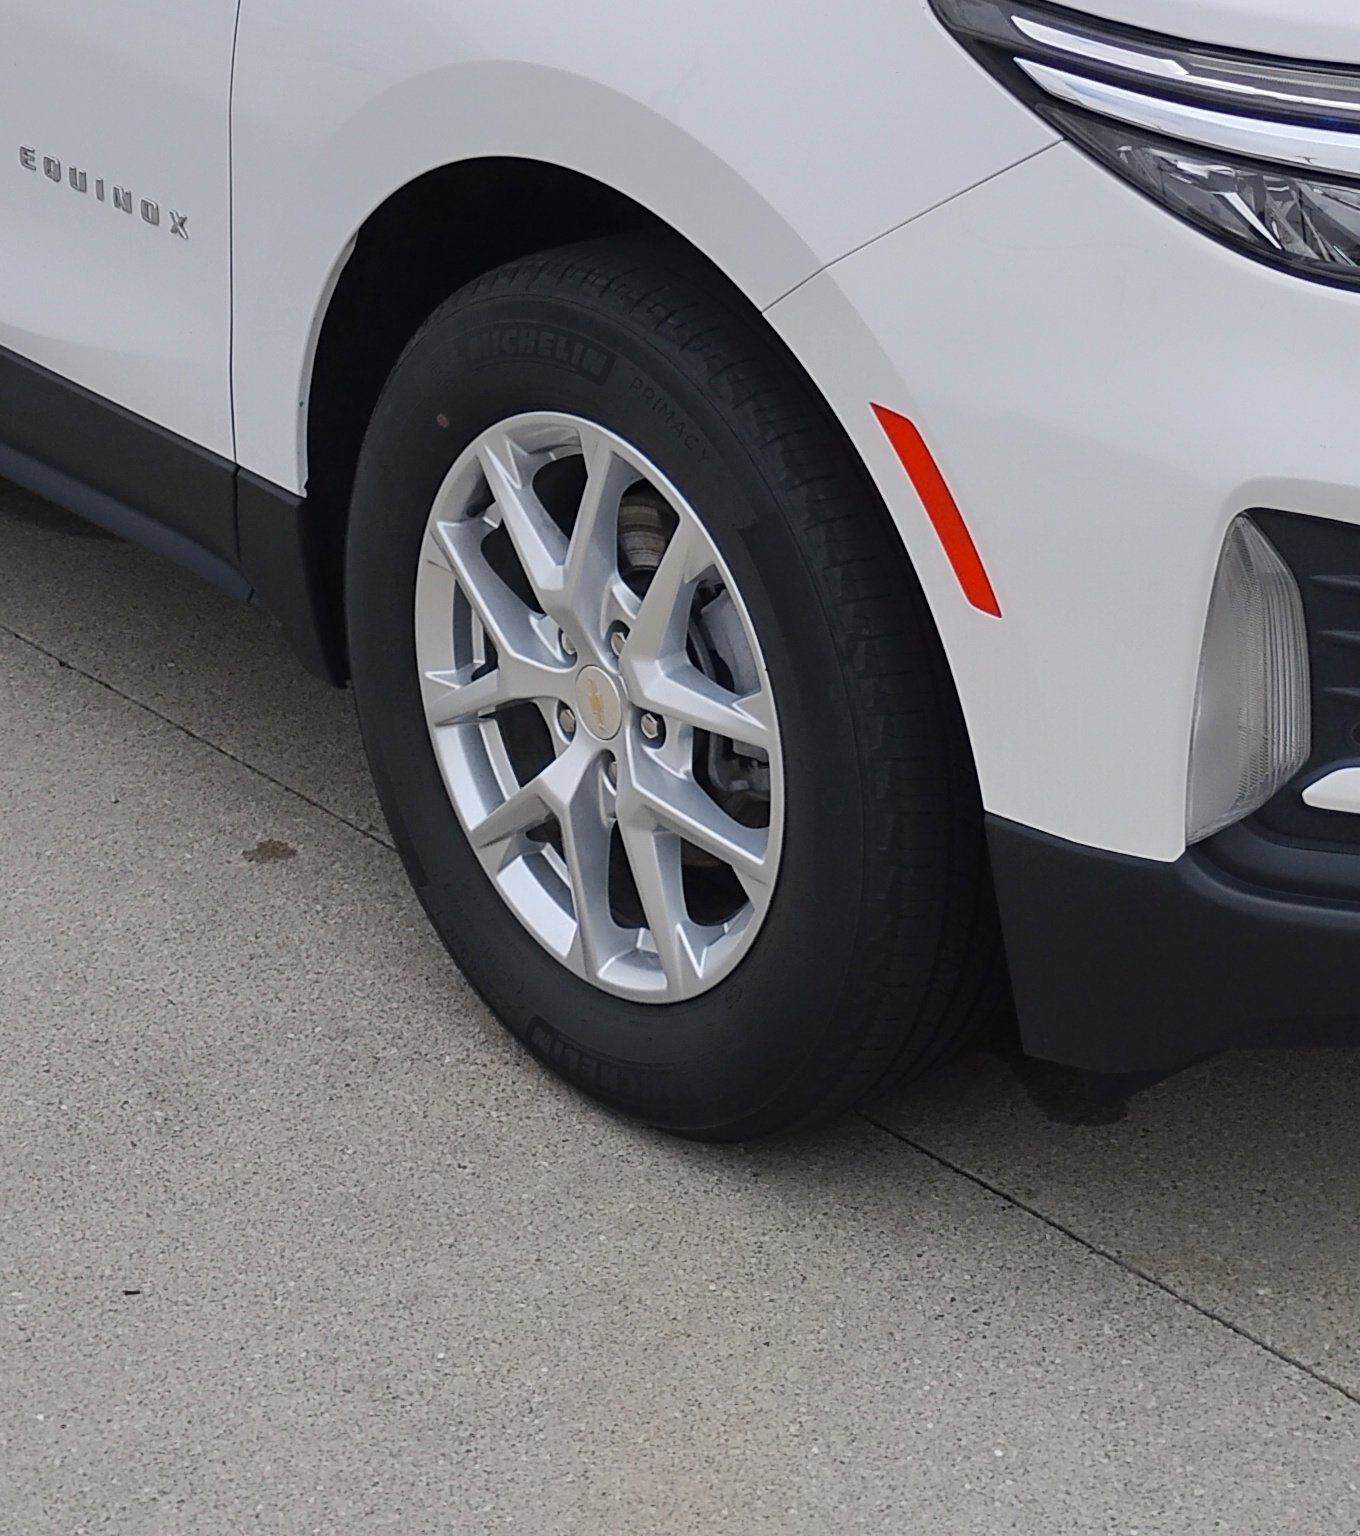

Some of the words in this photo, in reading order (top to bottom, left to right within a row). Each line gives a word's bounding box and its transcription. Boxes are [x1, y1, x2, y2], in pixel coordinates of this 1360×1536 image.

[18, 144, 189, 241] EQUINOX
[468, 324, 608, 378] MICHELIN
[627, 375, 717, 463] PRIMACY
